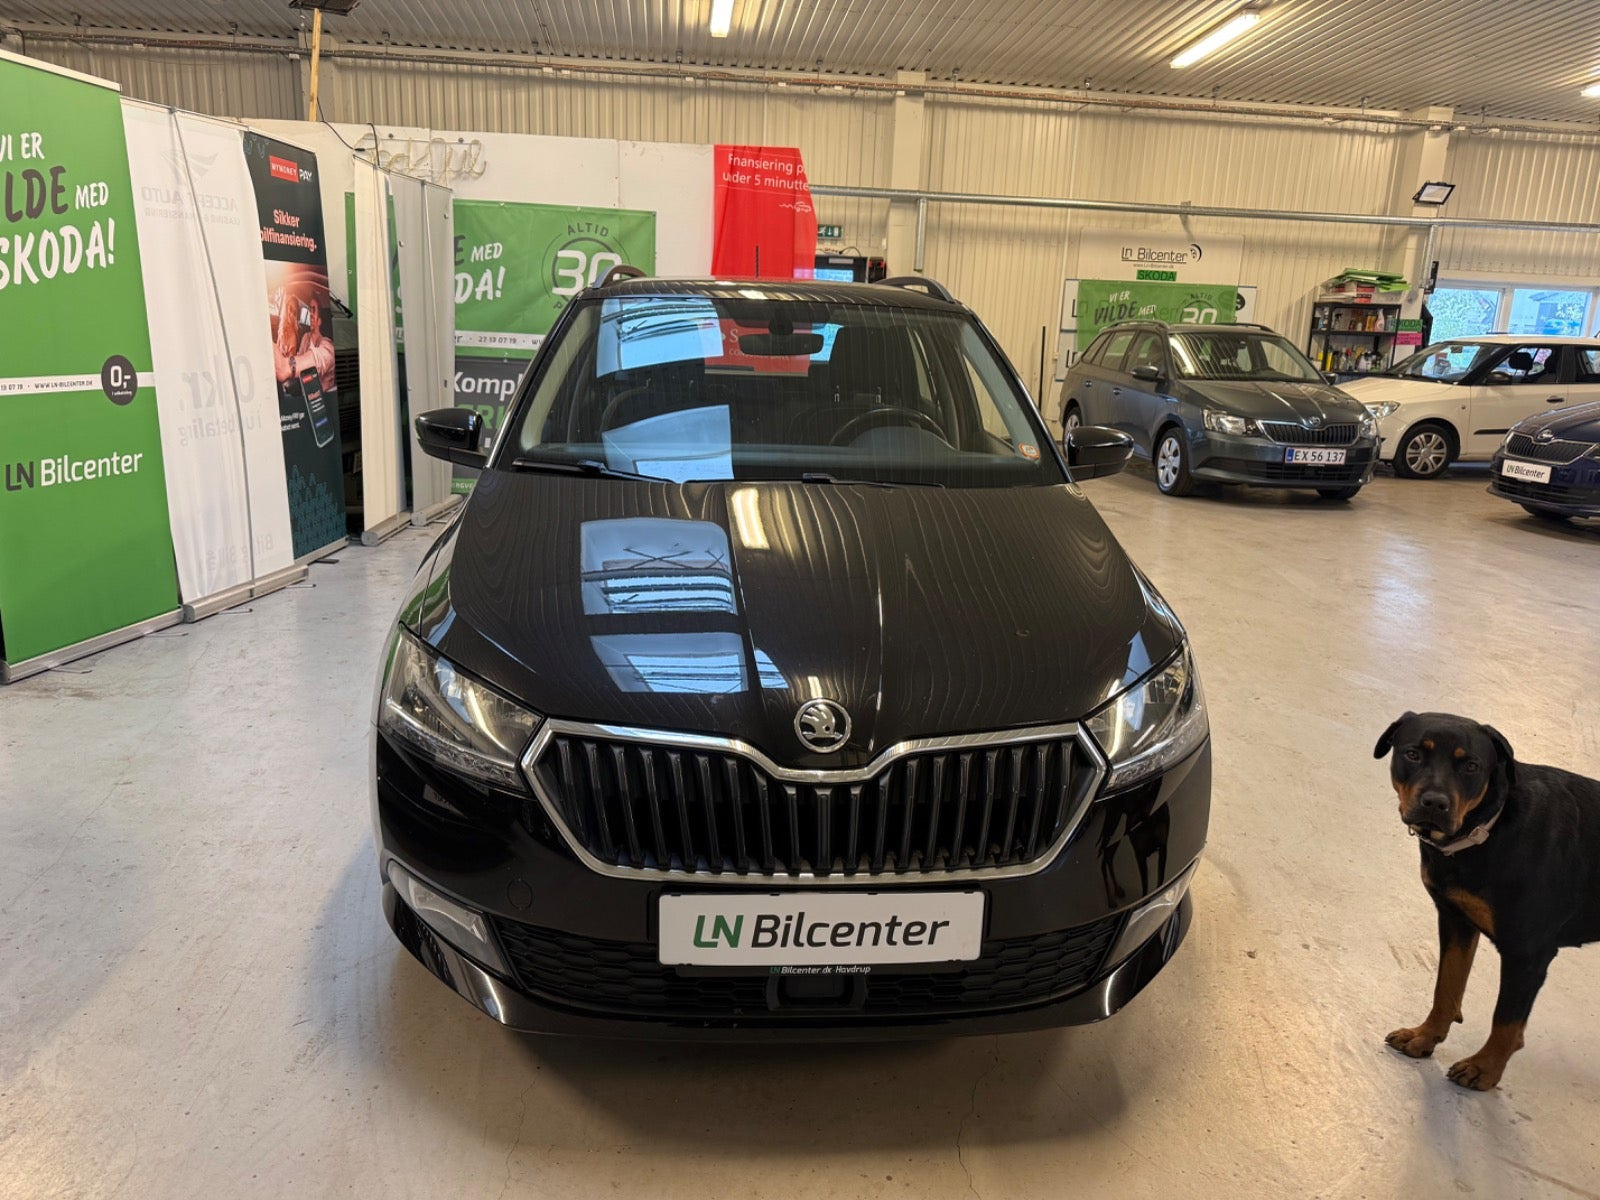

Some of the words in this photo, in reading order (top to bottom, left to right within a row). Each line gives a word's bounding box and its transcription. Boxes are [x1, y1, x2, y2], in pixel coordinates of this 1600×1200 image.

[20, 132, 45, 159] ER
[754, 174, 761, 186] 5
[75, 181, 109, 210] MED
[273, 209, 300, 228] Sikker
[567, 222, 609, 237] ALTID
[0, 217, 115, 290] SKODA!
[470, 242, 503, 263] MED
[1137, 247, 1188, 262] Bilcenter
[552, 250, 623, 296] 30
[1138, 271, 1176, 281] SKODA
[1119, 291, 1130, 300] ER
[1094, 301, 1137, 325] VILDE
[1138, 304, 1156, 316] MED
[1294, 450, 1309, 461] EX
[1311, 451, 1323, 462] 56
[1326, 452, 1345, 463] 137
[5, 461, 34, 491] LN
[41, 451, 143, 487] Bilcenter
[1515, 465, 1545, 479] Bilcenter
[693, 914, 744, 948] LN
[751, 912, 950, 948] Bilcenter
[836, 965, 871, 974] Havdrup
